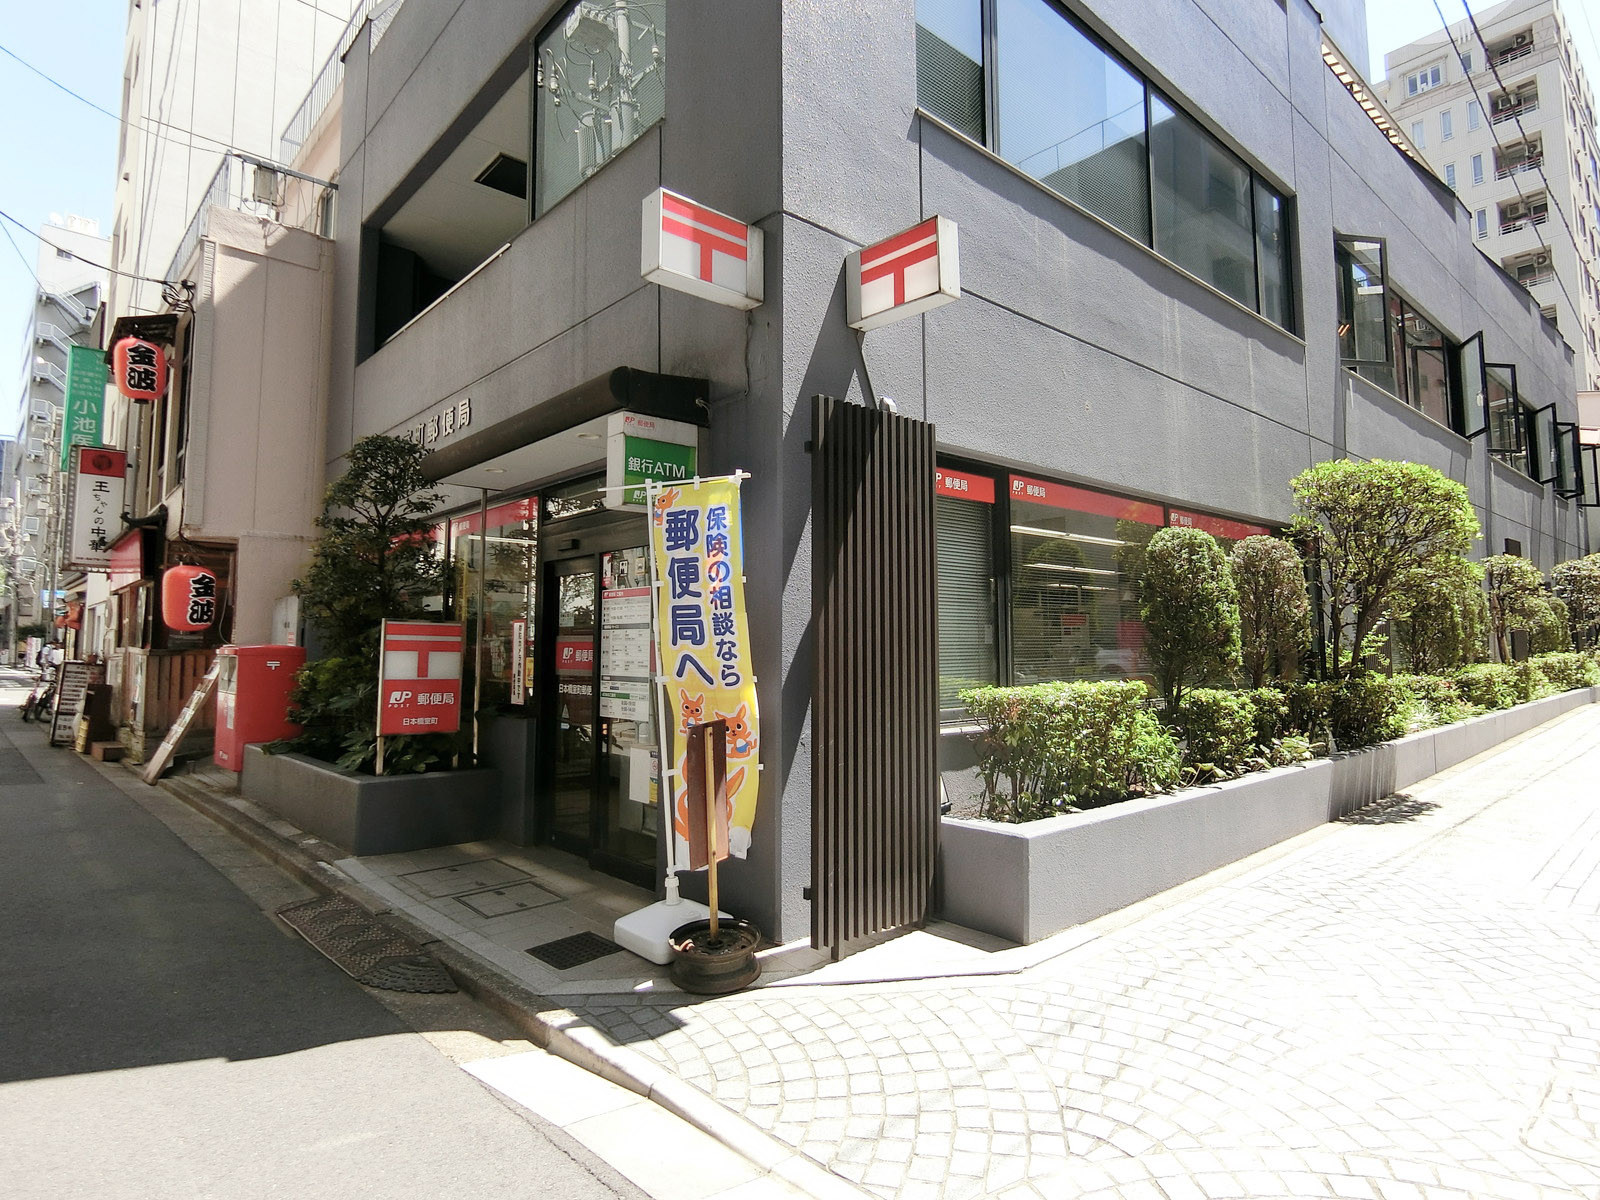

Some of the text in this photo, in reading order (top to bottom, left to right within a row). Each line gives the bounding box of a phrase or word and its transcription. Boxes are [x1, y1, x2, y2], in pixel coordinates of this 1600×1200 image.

[127, 344, 157, 392] 金波
[404, 398, 471, 446] 町郵便局
[627, 456, 686, 479] 銀行ATM
[945, 476, 968, 492] 郵便局
[1026, 484, 1046, 498] 郵便局
[187, 573, 216, 625] 金波
[665, 509, 714, 686] 郵便局へ
[706, 506, 741, 686] 保険の相談なら
[417, 693, 455, 705] 郵便局
